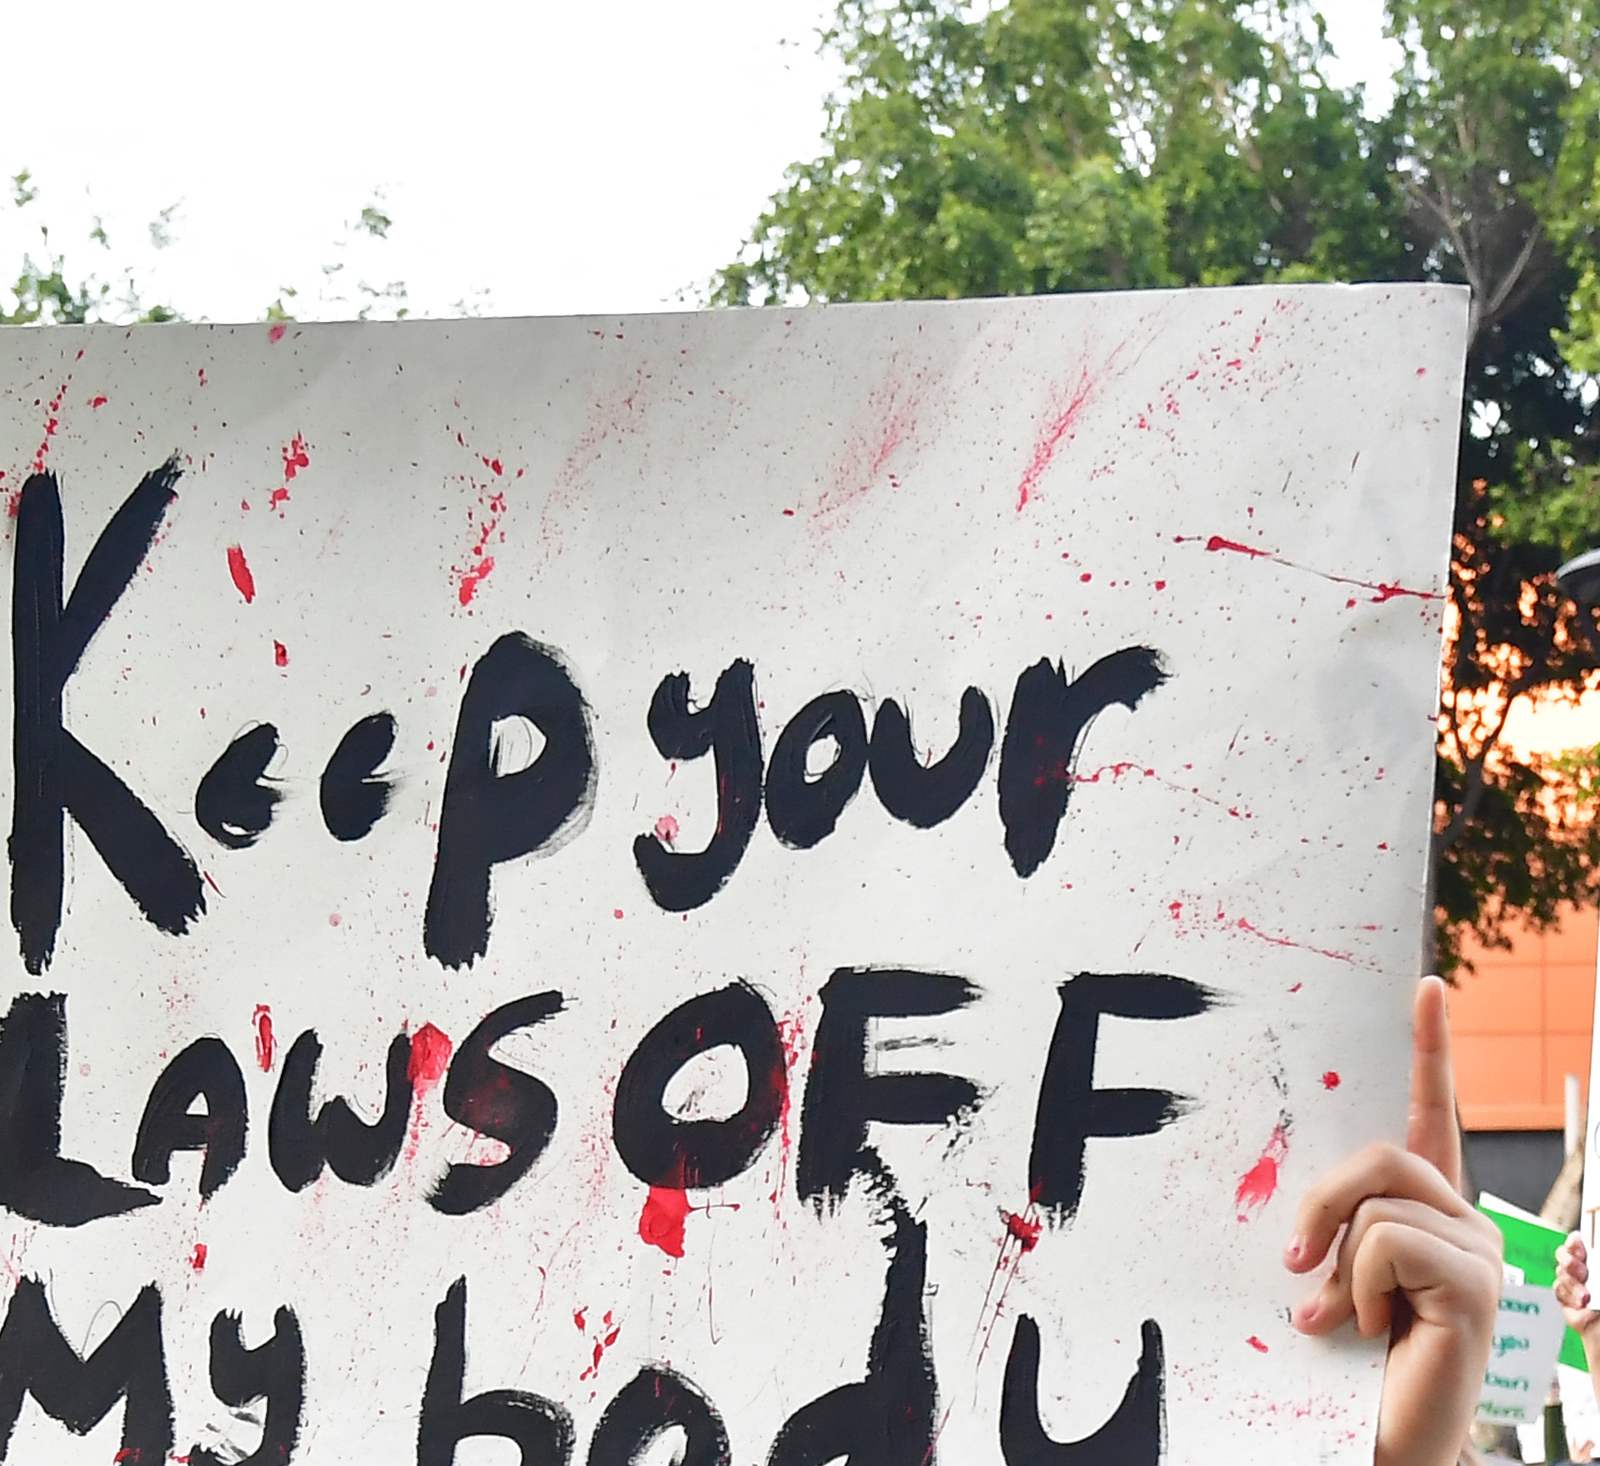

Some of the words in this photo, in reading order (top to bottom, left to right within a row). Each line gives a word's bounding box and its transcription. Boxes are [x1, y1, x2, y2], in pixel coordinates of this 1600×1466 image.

[7, 456, 600, 973] Keep
[636, 640, 1175, 916] your
[611, 968, 1227, 1221] OFF
